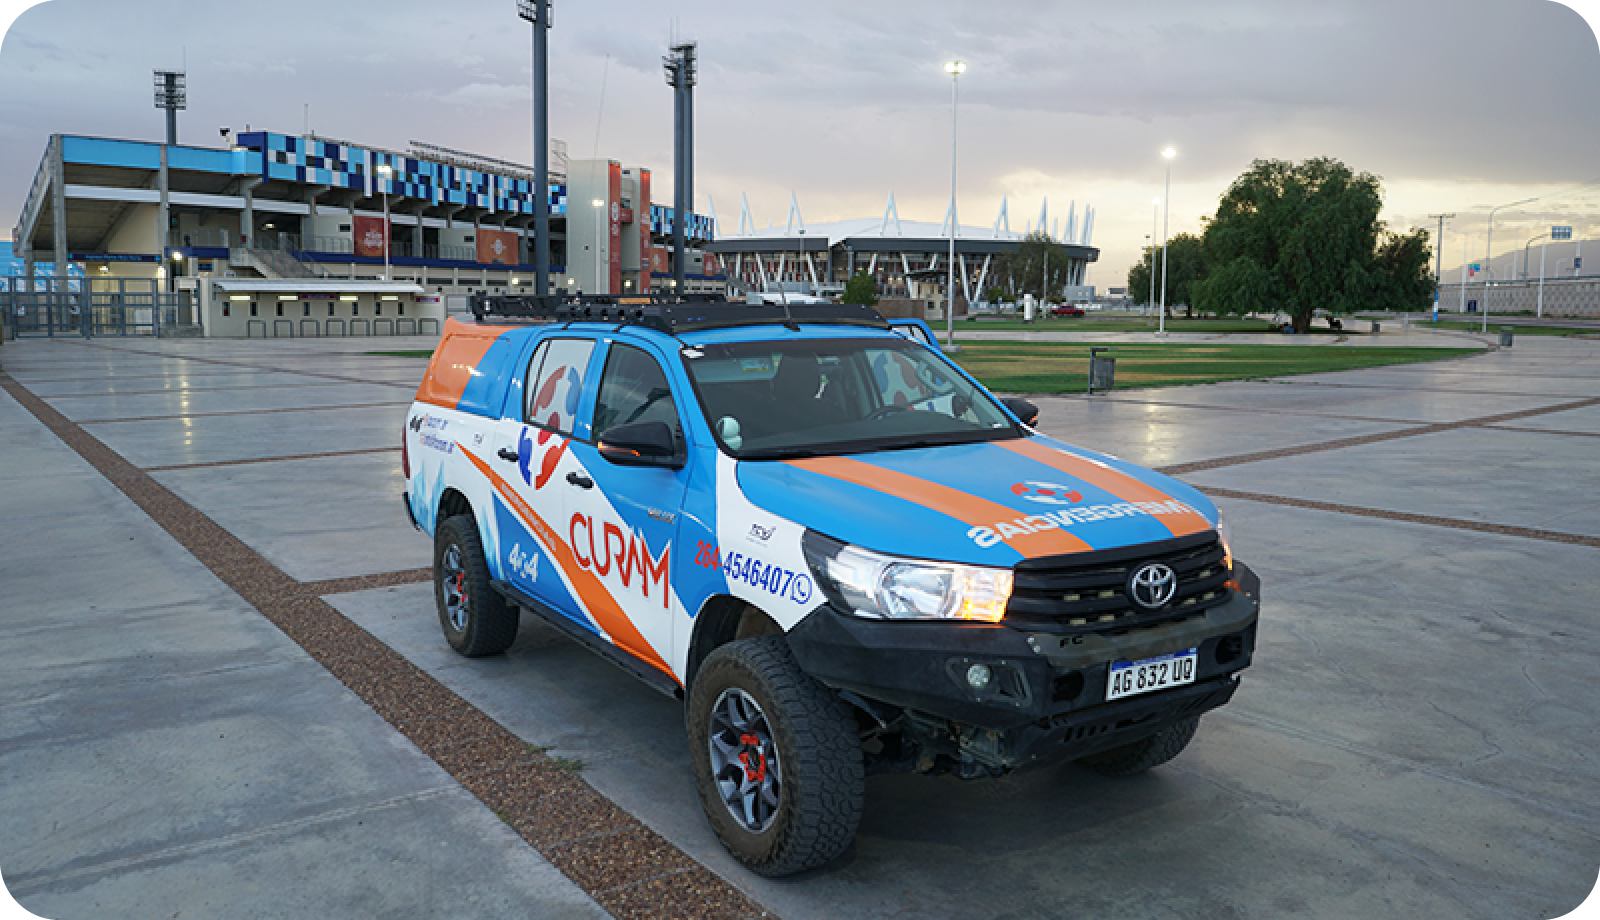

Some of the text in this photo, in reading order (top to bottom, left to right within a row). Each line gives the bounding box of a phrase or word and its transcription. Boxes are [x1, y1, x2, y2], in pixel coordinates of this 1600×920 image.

[569, 511, 671, 610] CURAM
[1111, 669, 1133, 696] AG
[1137, 662, 1169, 690] 832
